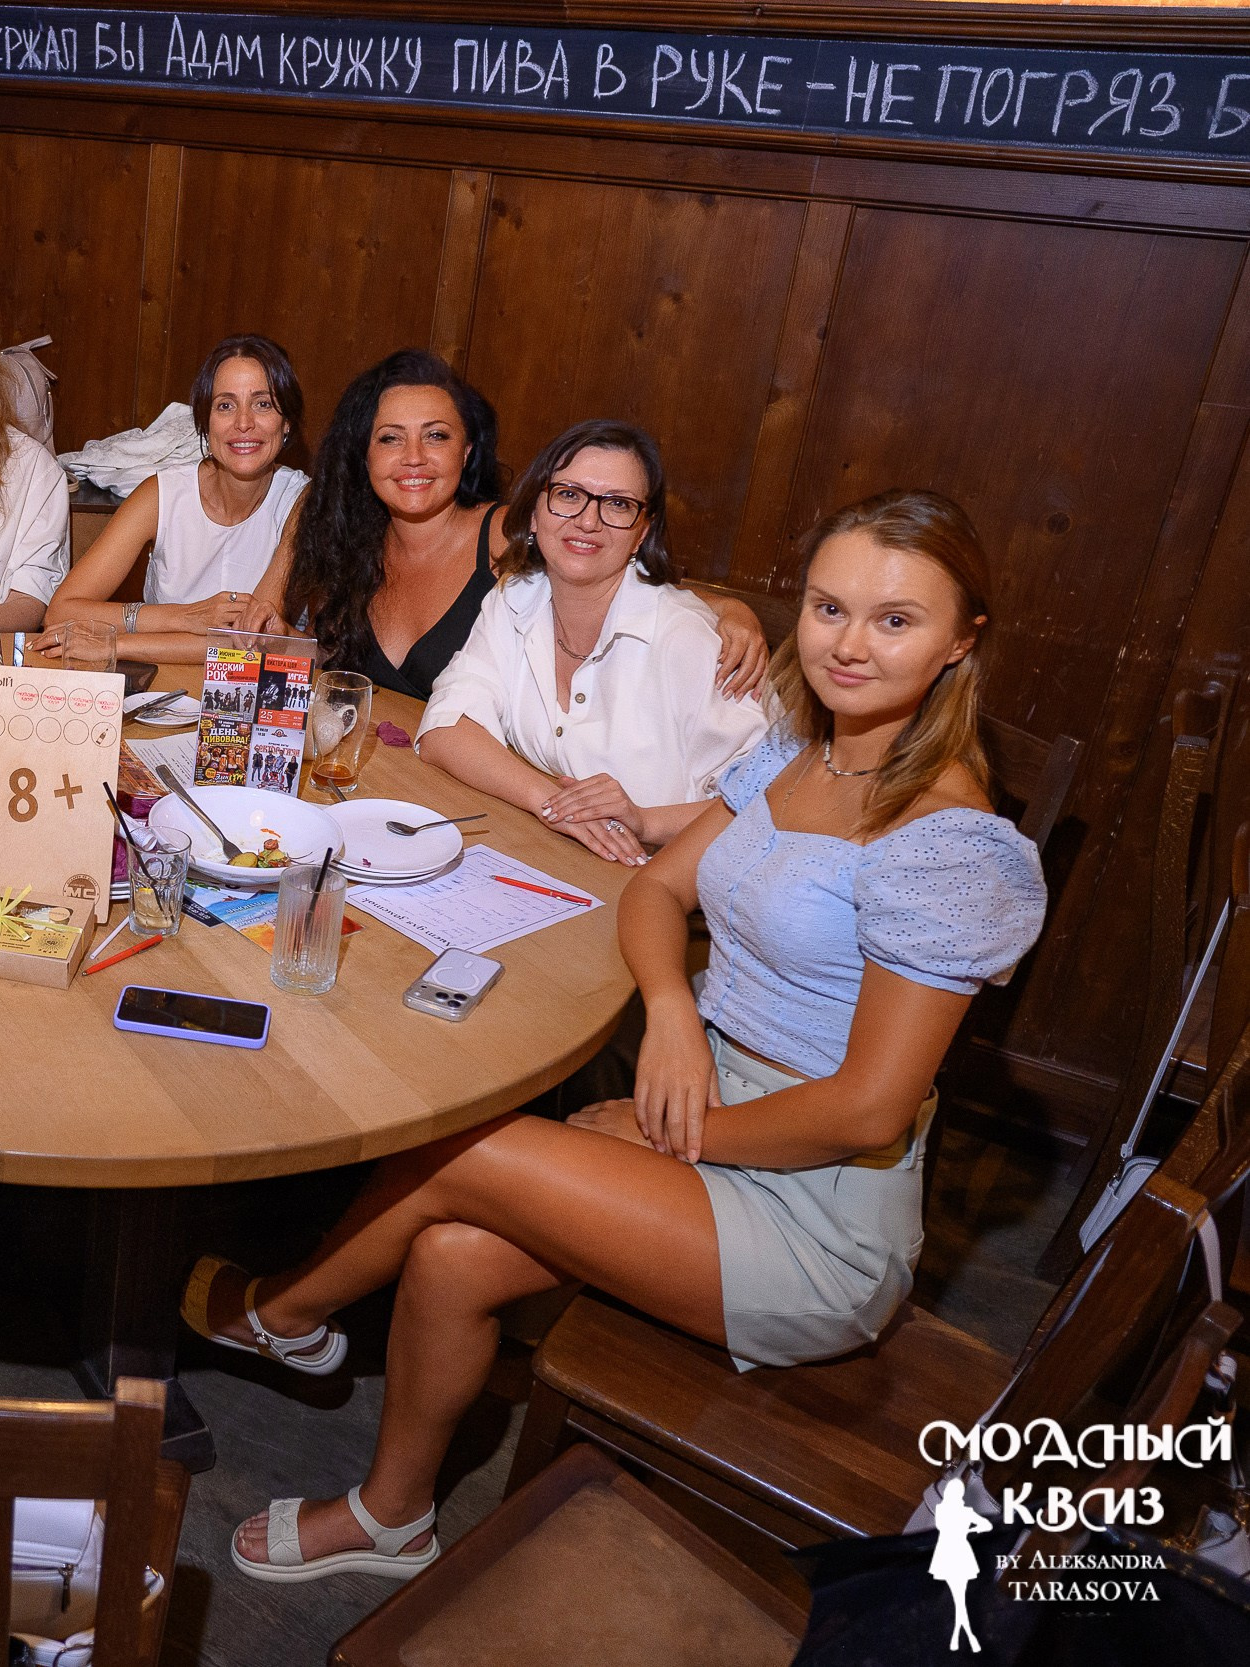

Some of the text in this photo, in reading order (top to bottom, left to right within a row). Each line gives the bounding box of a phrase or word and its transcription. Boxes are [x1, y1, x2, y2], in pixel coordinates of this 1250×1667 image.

[95, 22, 145, 73] БЫ
[279, 33, 423, 94] КРУЖКУ
[452, 38, 570, 100] ПИВА
[594, 43, 627, 99] В
[651, 44, 793, 116] РУКЕ
[208, 648, 218, 656] 28
[206, 662, 245, 672] РУССКИЙ
[206, 671, 228, 681] РОК
[287, 672, 308, 682] ИГРА
[260, 710, 273, 720] 25
[209, 727, 238, 736] ДЕНЬ
[202, 735, 248, 744] ПИВОВАРА!
